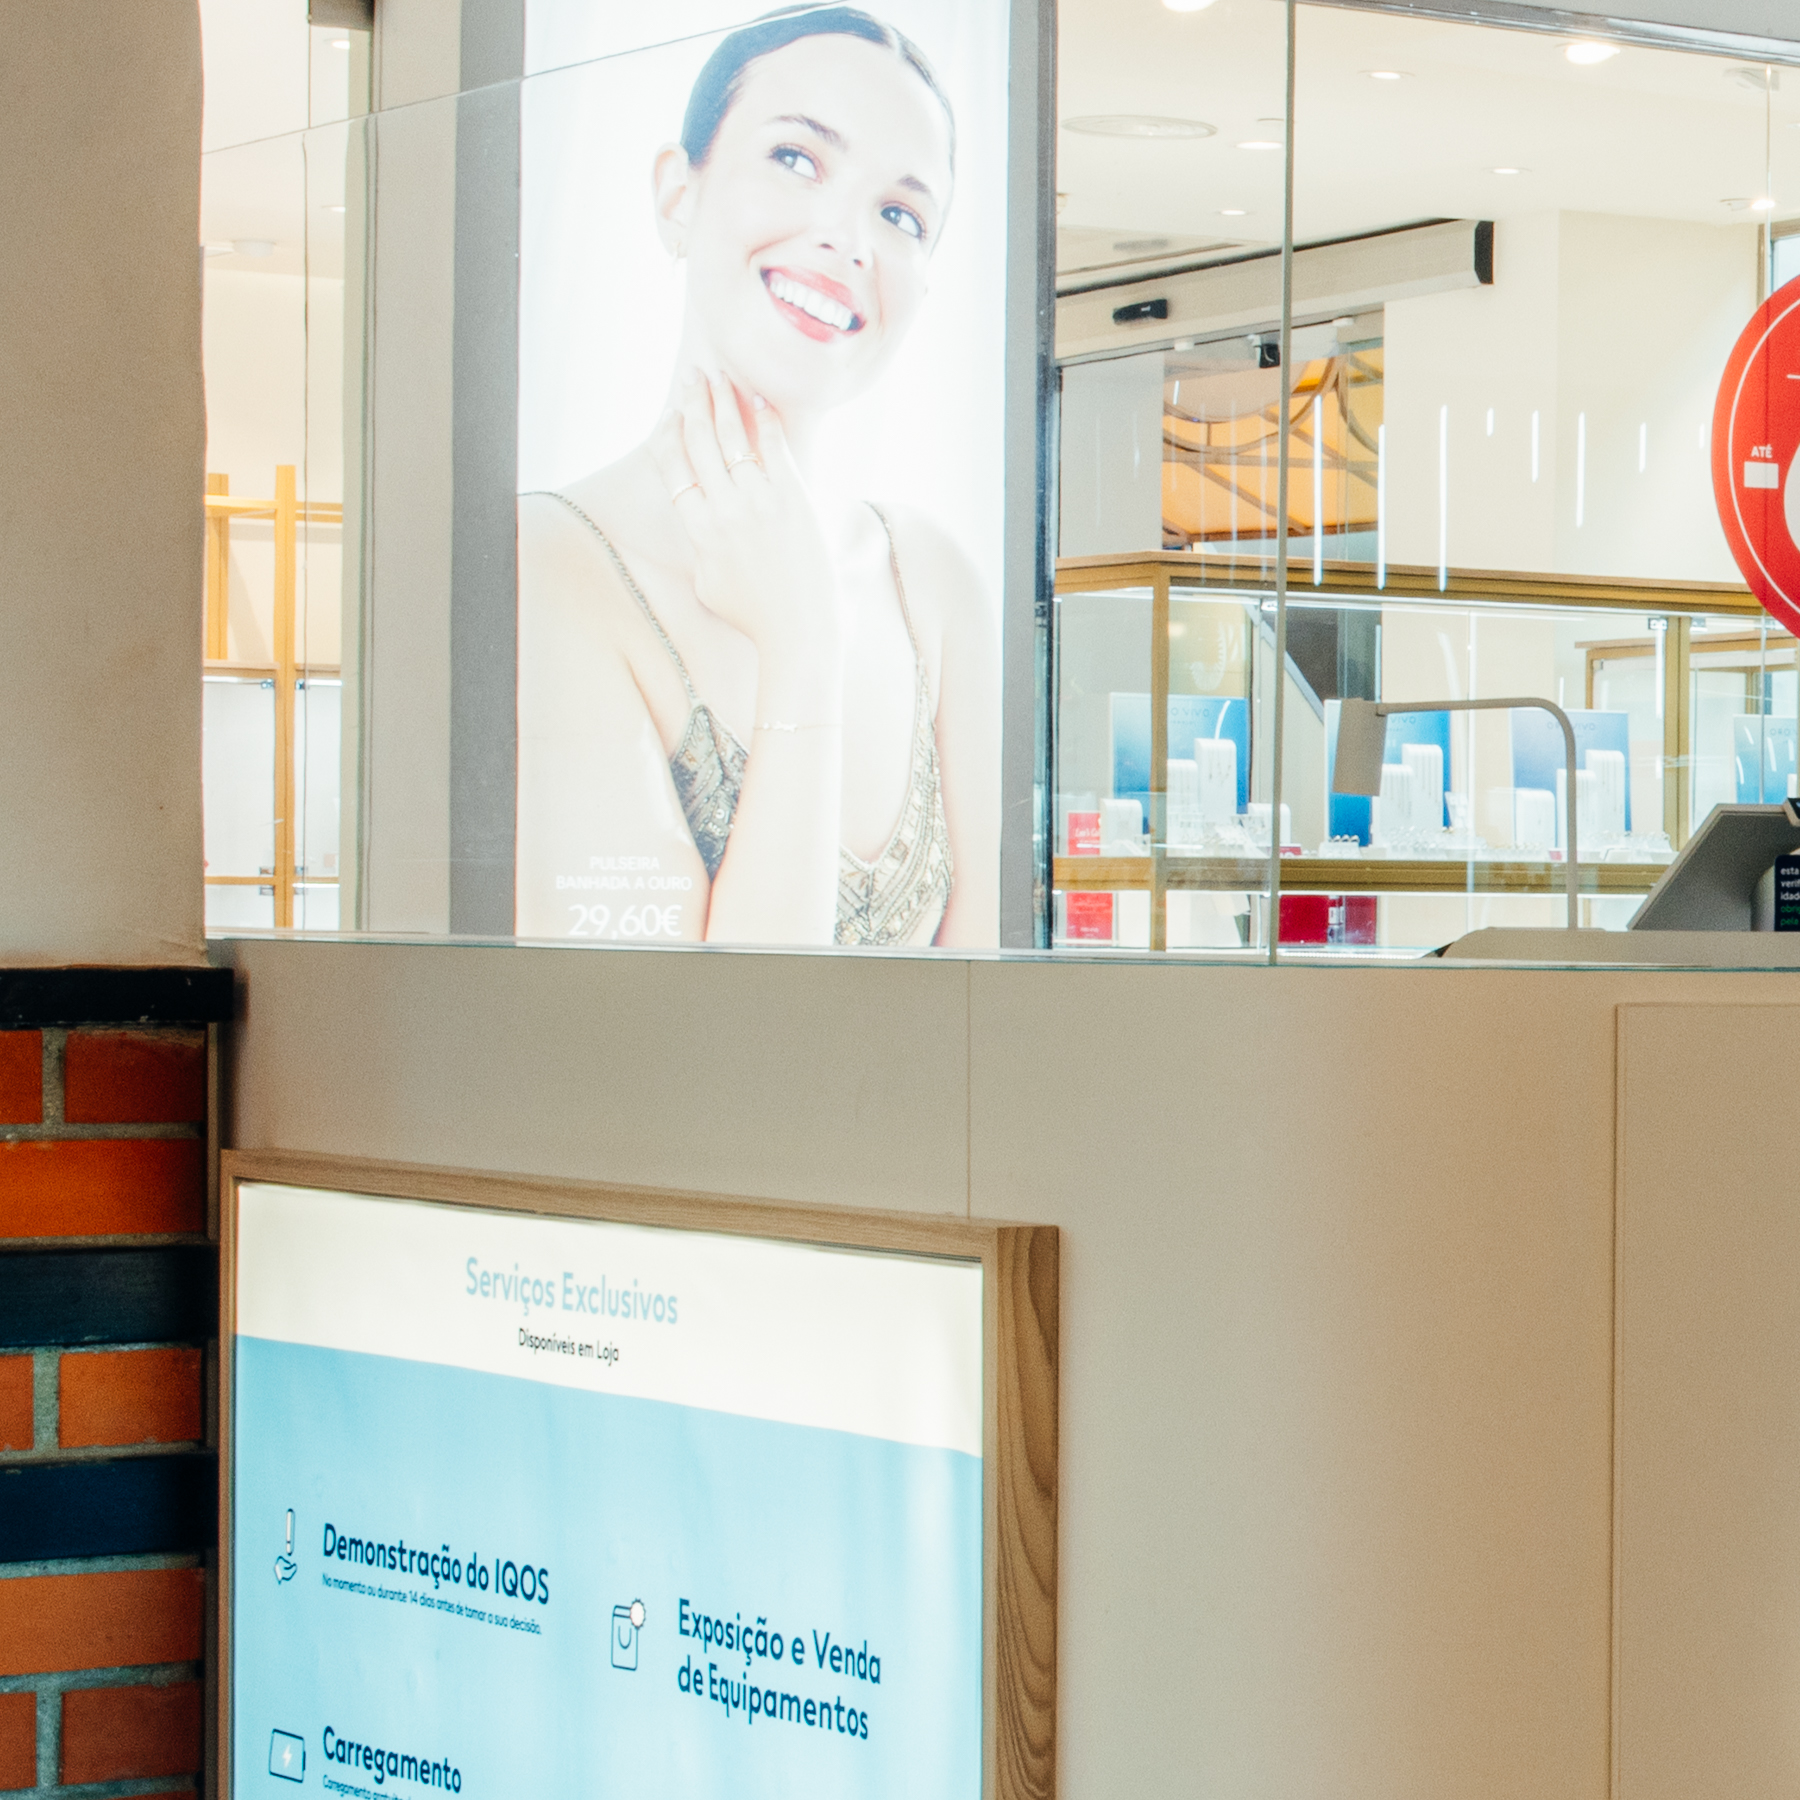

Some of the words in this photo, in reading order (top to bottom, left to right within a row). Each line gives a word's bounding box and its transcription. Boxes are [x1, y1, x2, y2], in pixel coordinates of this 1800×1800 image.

[1751, 444, 1772, 458] ATÉ
[590, 856, 660, 870] PULSEIRA
[1781, 867, 1799, 875] esta
[556, 876, 630, 890] BANHADA
[635, 877, 645, 890] A
[648, 876, 693, 891] OURO
[568, 904, 682, 940] 29,60€
[1781, 918, 1798, 927] pela
[466, 1256, 555, 1316] Serviços
[562, 1271, 678, 1324] Exclusivos
[519, 1328, 575, 1354] Disponíveis
[579, 1342, 594, 1358] em
[597, 1340, 619, 1367] Loja
[323, 1523, 461, 1589] Demonstração
[466, 1552, 489, 1590] do
[495, 1558, 549, 1604] IQOS
[409, 1590, 418, 1603] 14
[419, 1593, 435, 1608] dias
[494, 1616, 508, 1627] sua
[679, 1597, 784, 1666] Exposição
[791, 1637, 805, 1665] e
[812, 1628, 880, 1684] Venda
[678, 1654, 704, 1695] de
[709, 1662, 868, 1740] Equipamentos
[323, 1726, 461, 1793] Carregamento
